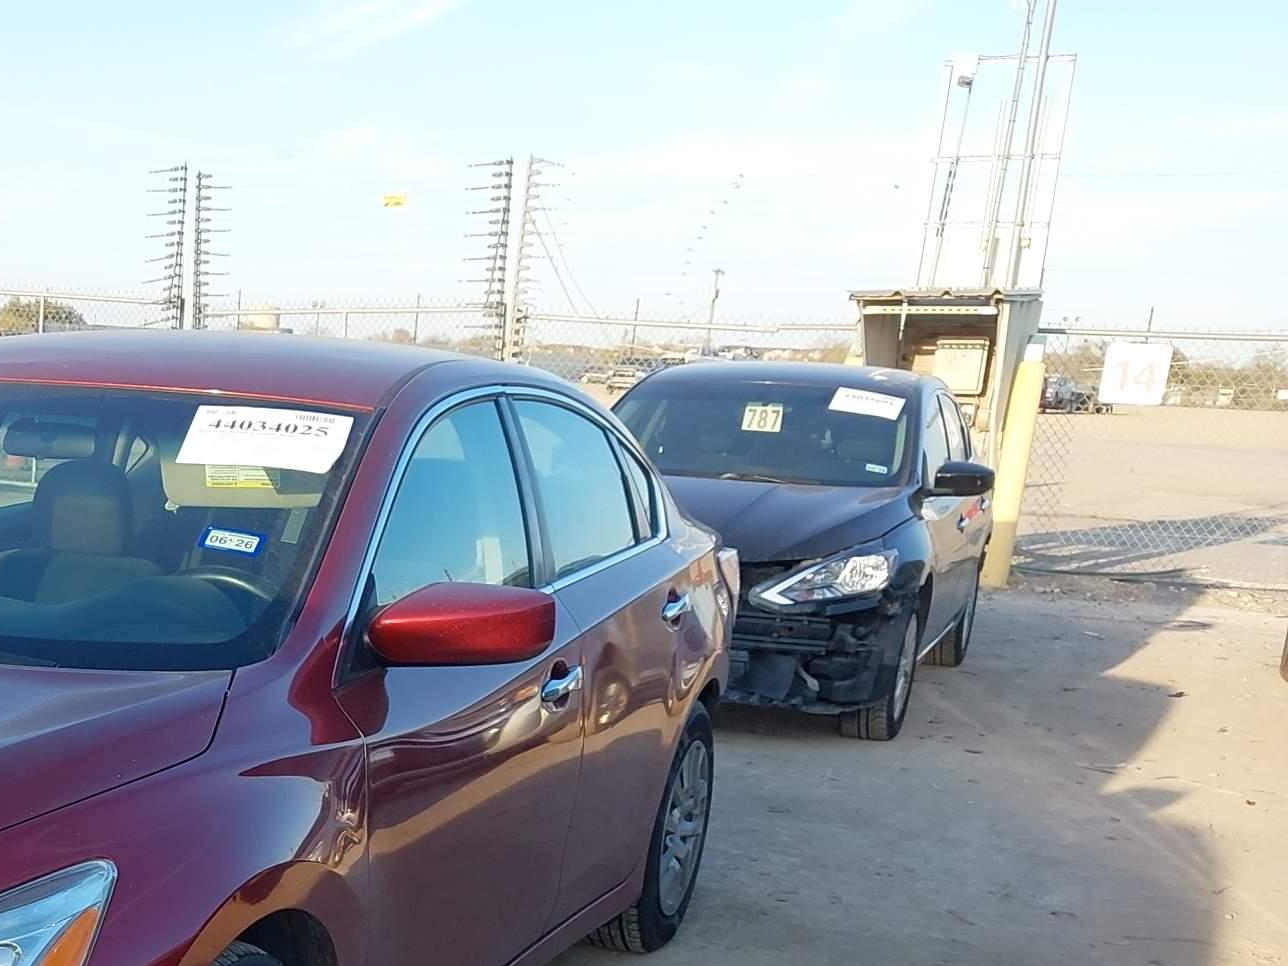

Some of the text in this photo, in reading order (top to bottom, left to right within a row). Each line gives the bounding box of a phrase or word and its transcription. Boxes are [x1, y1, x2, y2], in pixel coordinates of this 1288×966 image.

[1114, 360, 1159, 393] 14
[208, 419, 329, 437] 44034025
[746, 408, 780, 430] 787
[209, 535, 255, 549] 06 26
